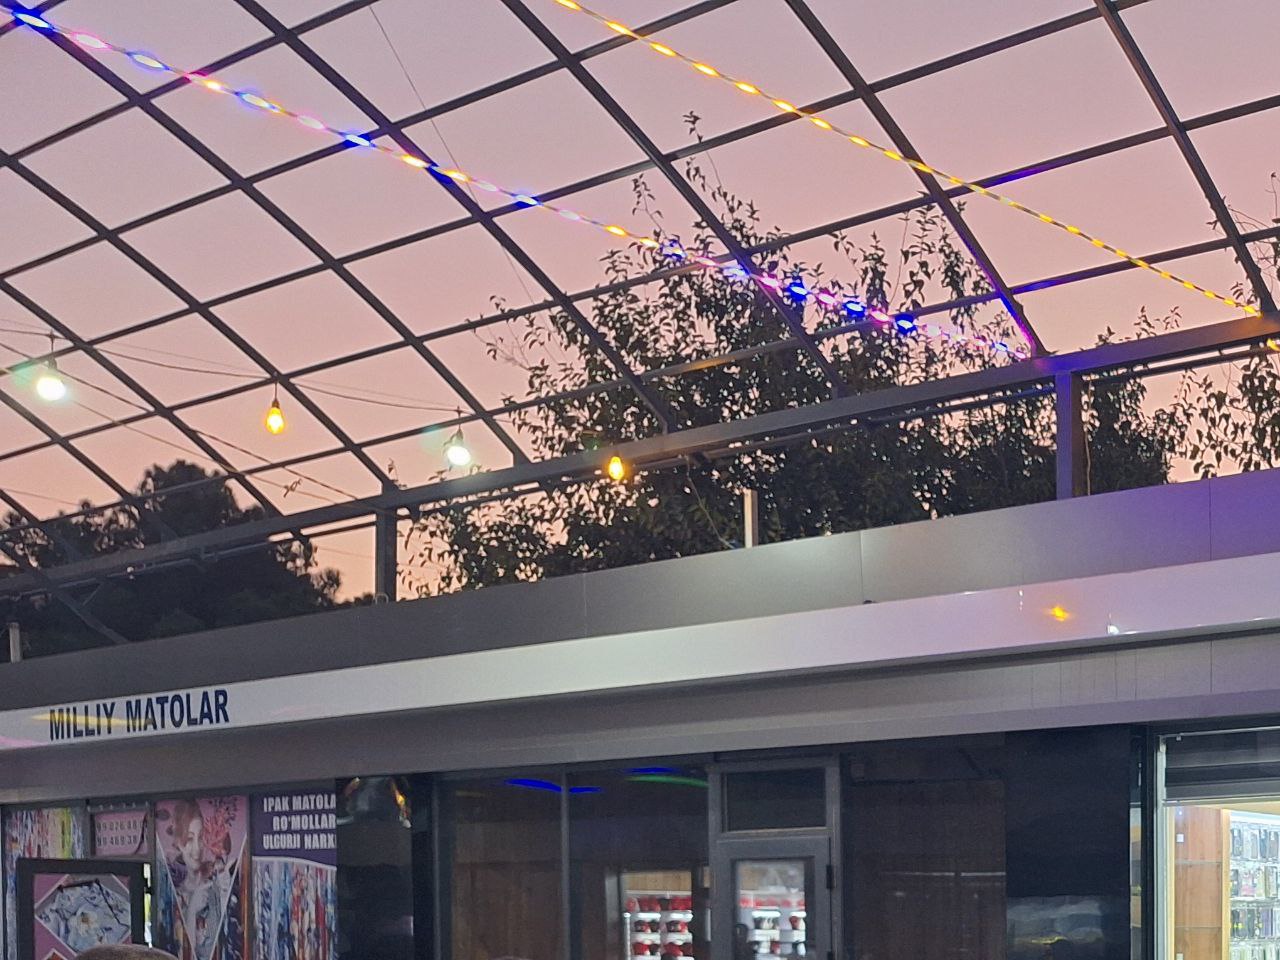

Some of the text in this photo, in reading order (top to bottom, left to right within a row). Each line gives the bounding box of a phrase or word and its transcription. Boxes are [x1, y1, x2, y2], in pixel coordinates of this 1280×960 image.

[50, 690, 230, 741] MILLIY MATOLAR
[263, 796, 289, 812] IPAK
